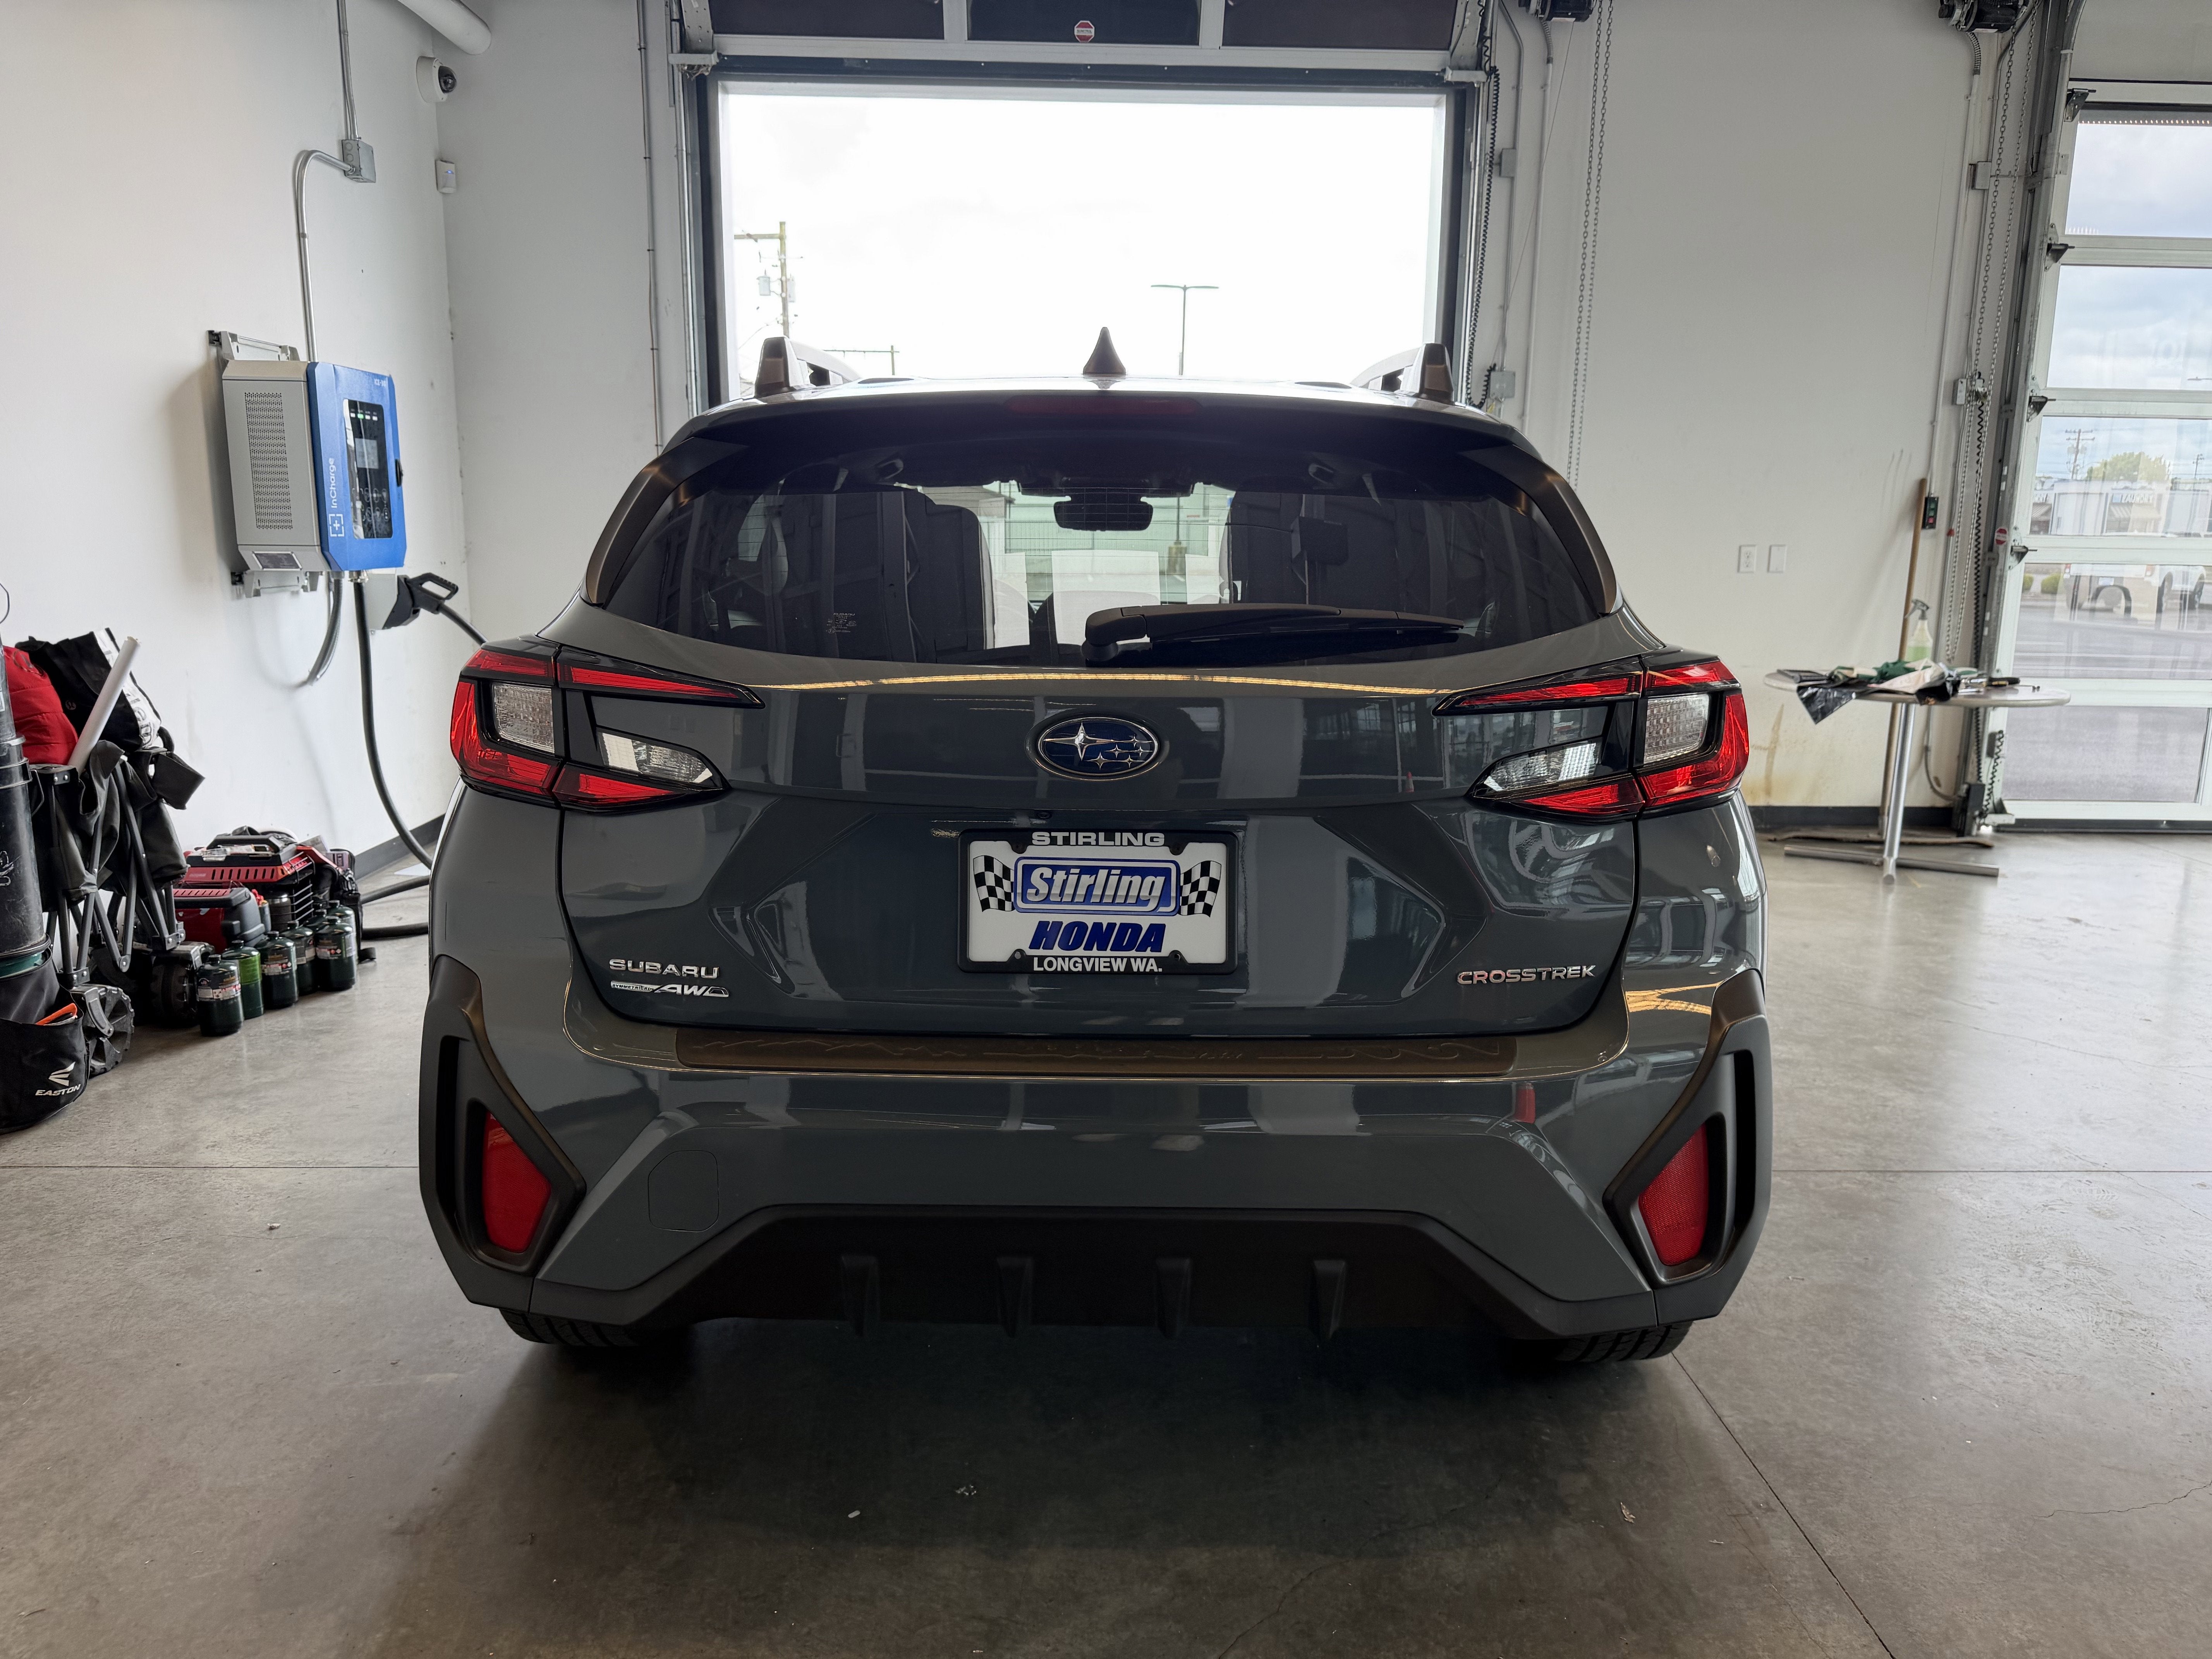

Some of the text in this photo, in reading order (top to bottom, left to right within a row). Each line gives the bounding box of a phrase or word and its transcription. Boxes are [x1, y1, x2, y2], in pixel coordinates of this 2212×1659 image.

[329, 458, 337, 508] InCharge
[1031, 831, 1165, 847] STIRLING
[1026, 867, 1166, 912] Stirling
[1028, 921, 1166, 953] HONDA
[609, 959, 720, 979] SUBARU
[1033, 957, 1163, 972] LONGVIEW WA.
[1457, 965, 1596, 984] CROSSTREK
[654, 984, 729, 998] AWD
[35, 1084, 81, 1096] EASTON
